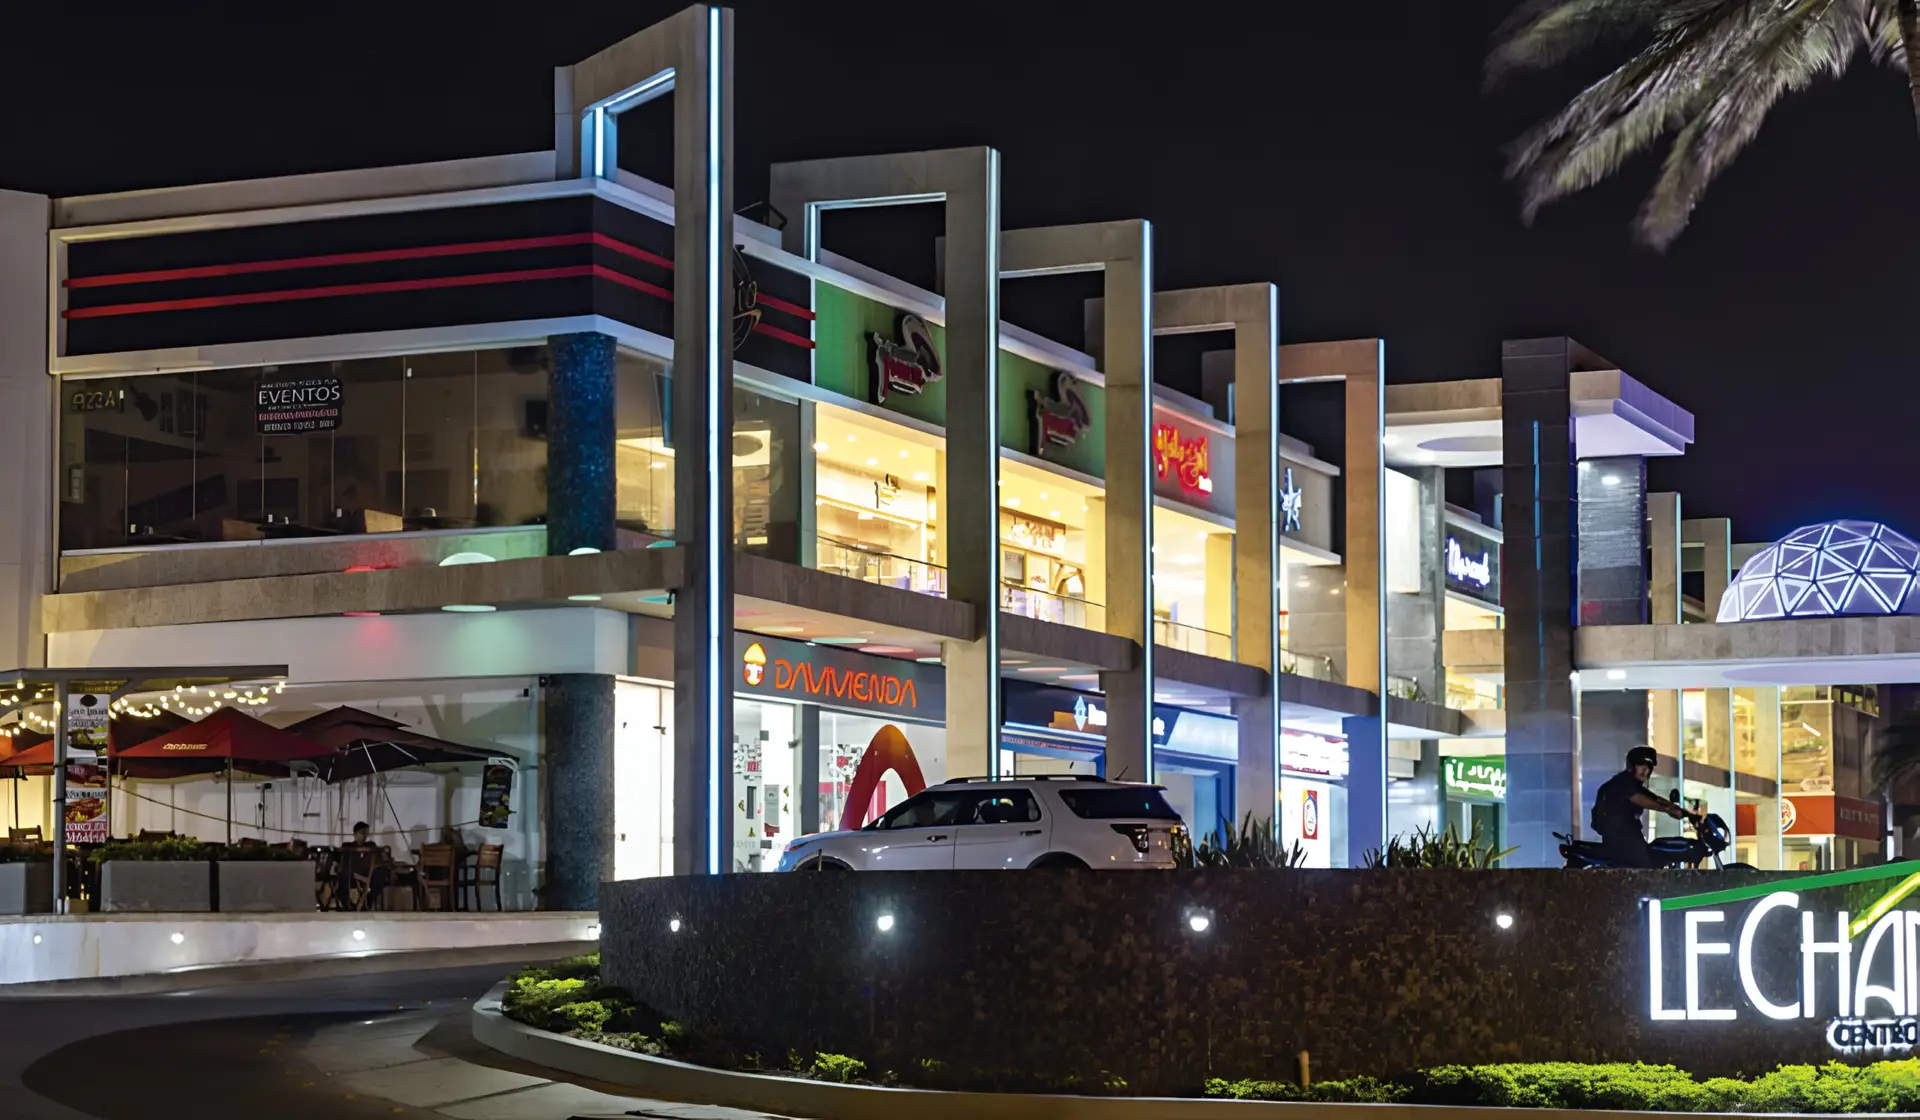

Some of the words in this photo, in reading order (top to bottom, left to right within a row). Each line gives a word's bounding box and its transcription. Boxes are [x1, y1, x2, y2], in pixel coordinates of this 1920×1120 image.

[258, 385, 340, 405] EVENTOS
[774, 659, 917, 709] DAVIVIENDA
[1831, 1021, 1919, 1048] CENTRO
